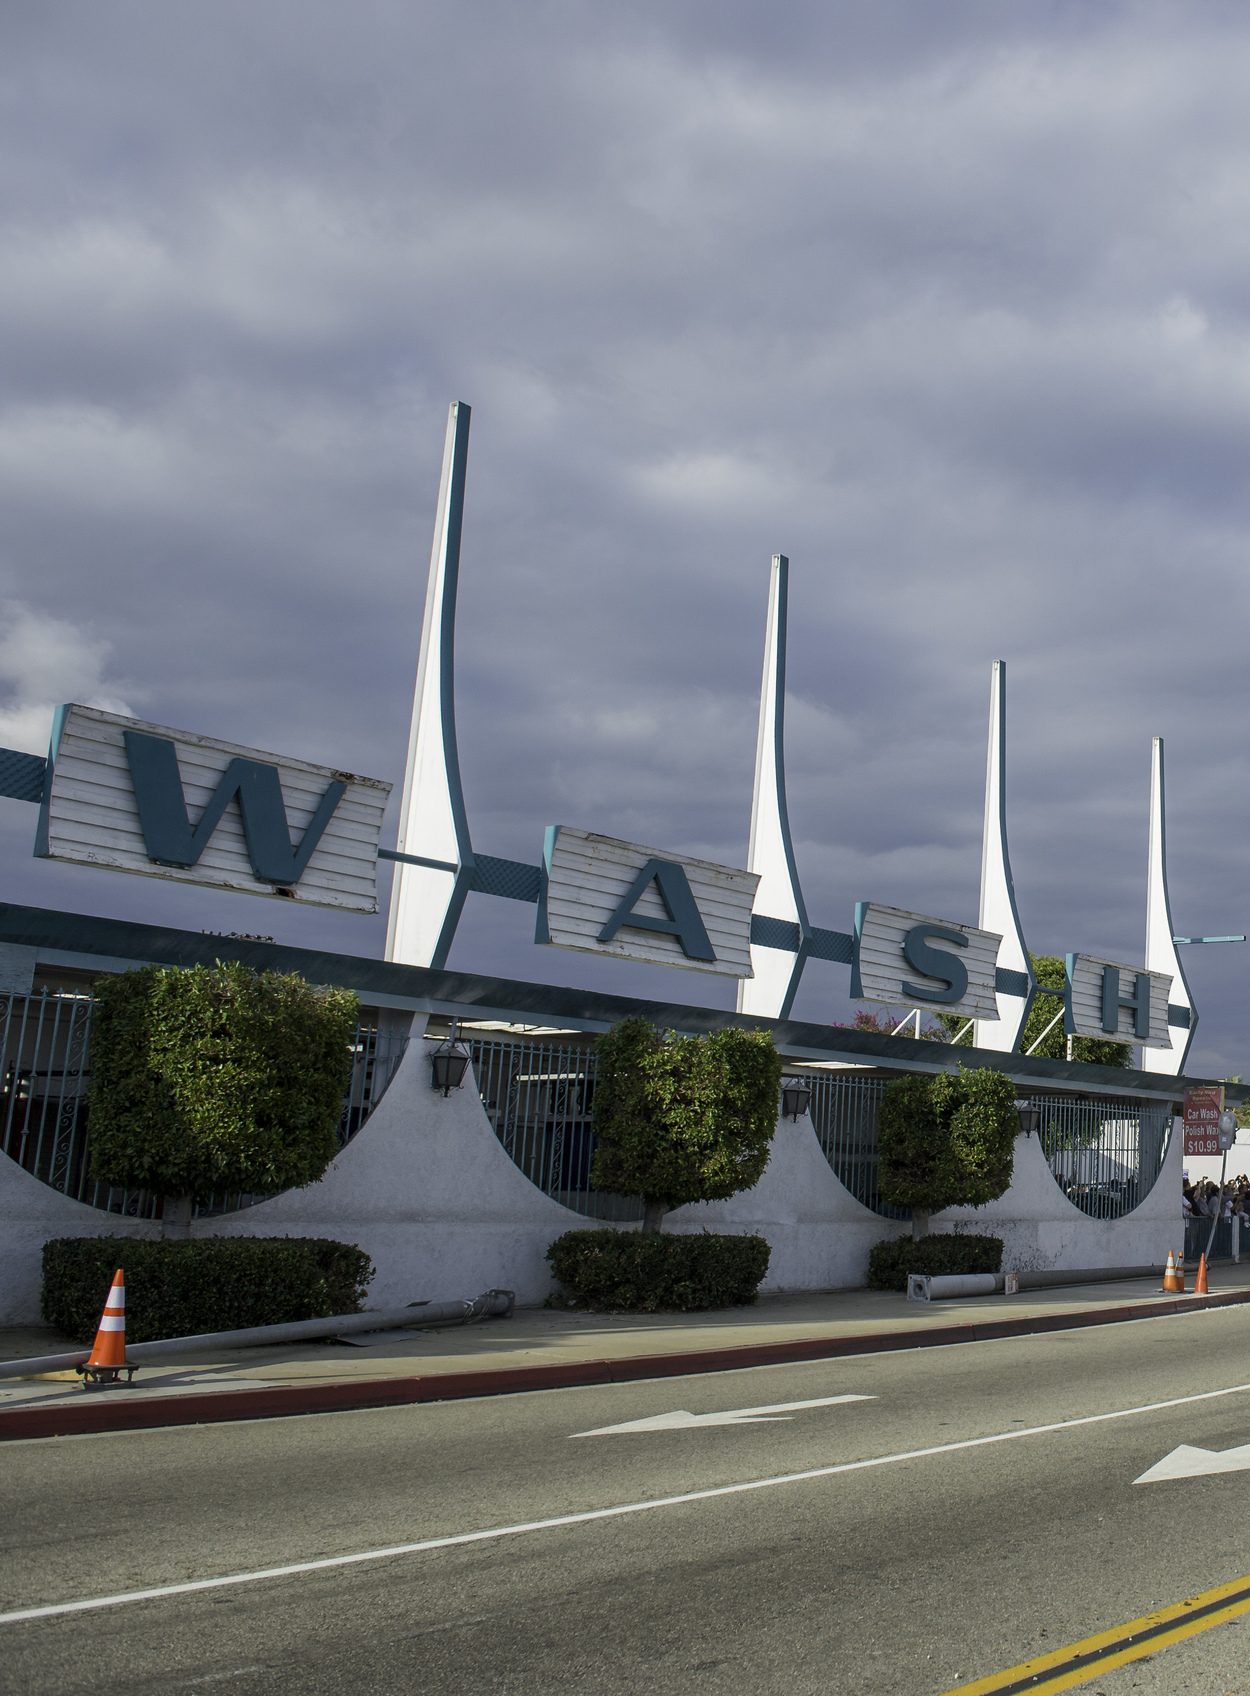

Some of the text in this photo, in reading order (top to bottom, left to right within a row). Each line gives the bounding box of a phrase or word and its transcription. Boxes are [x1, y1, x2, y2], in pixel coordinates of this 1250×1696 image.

[1187, 1108, 1218, 1120] Car Wash
[1185, 1125, 1205, 1136] Polish
[1188, 1140, 1218, 1153] $10.99
